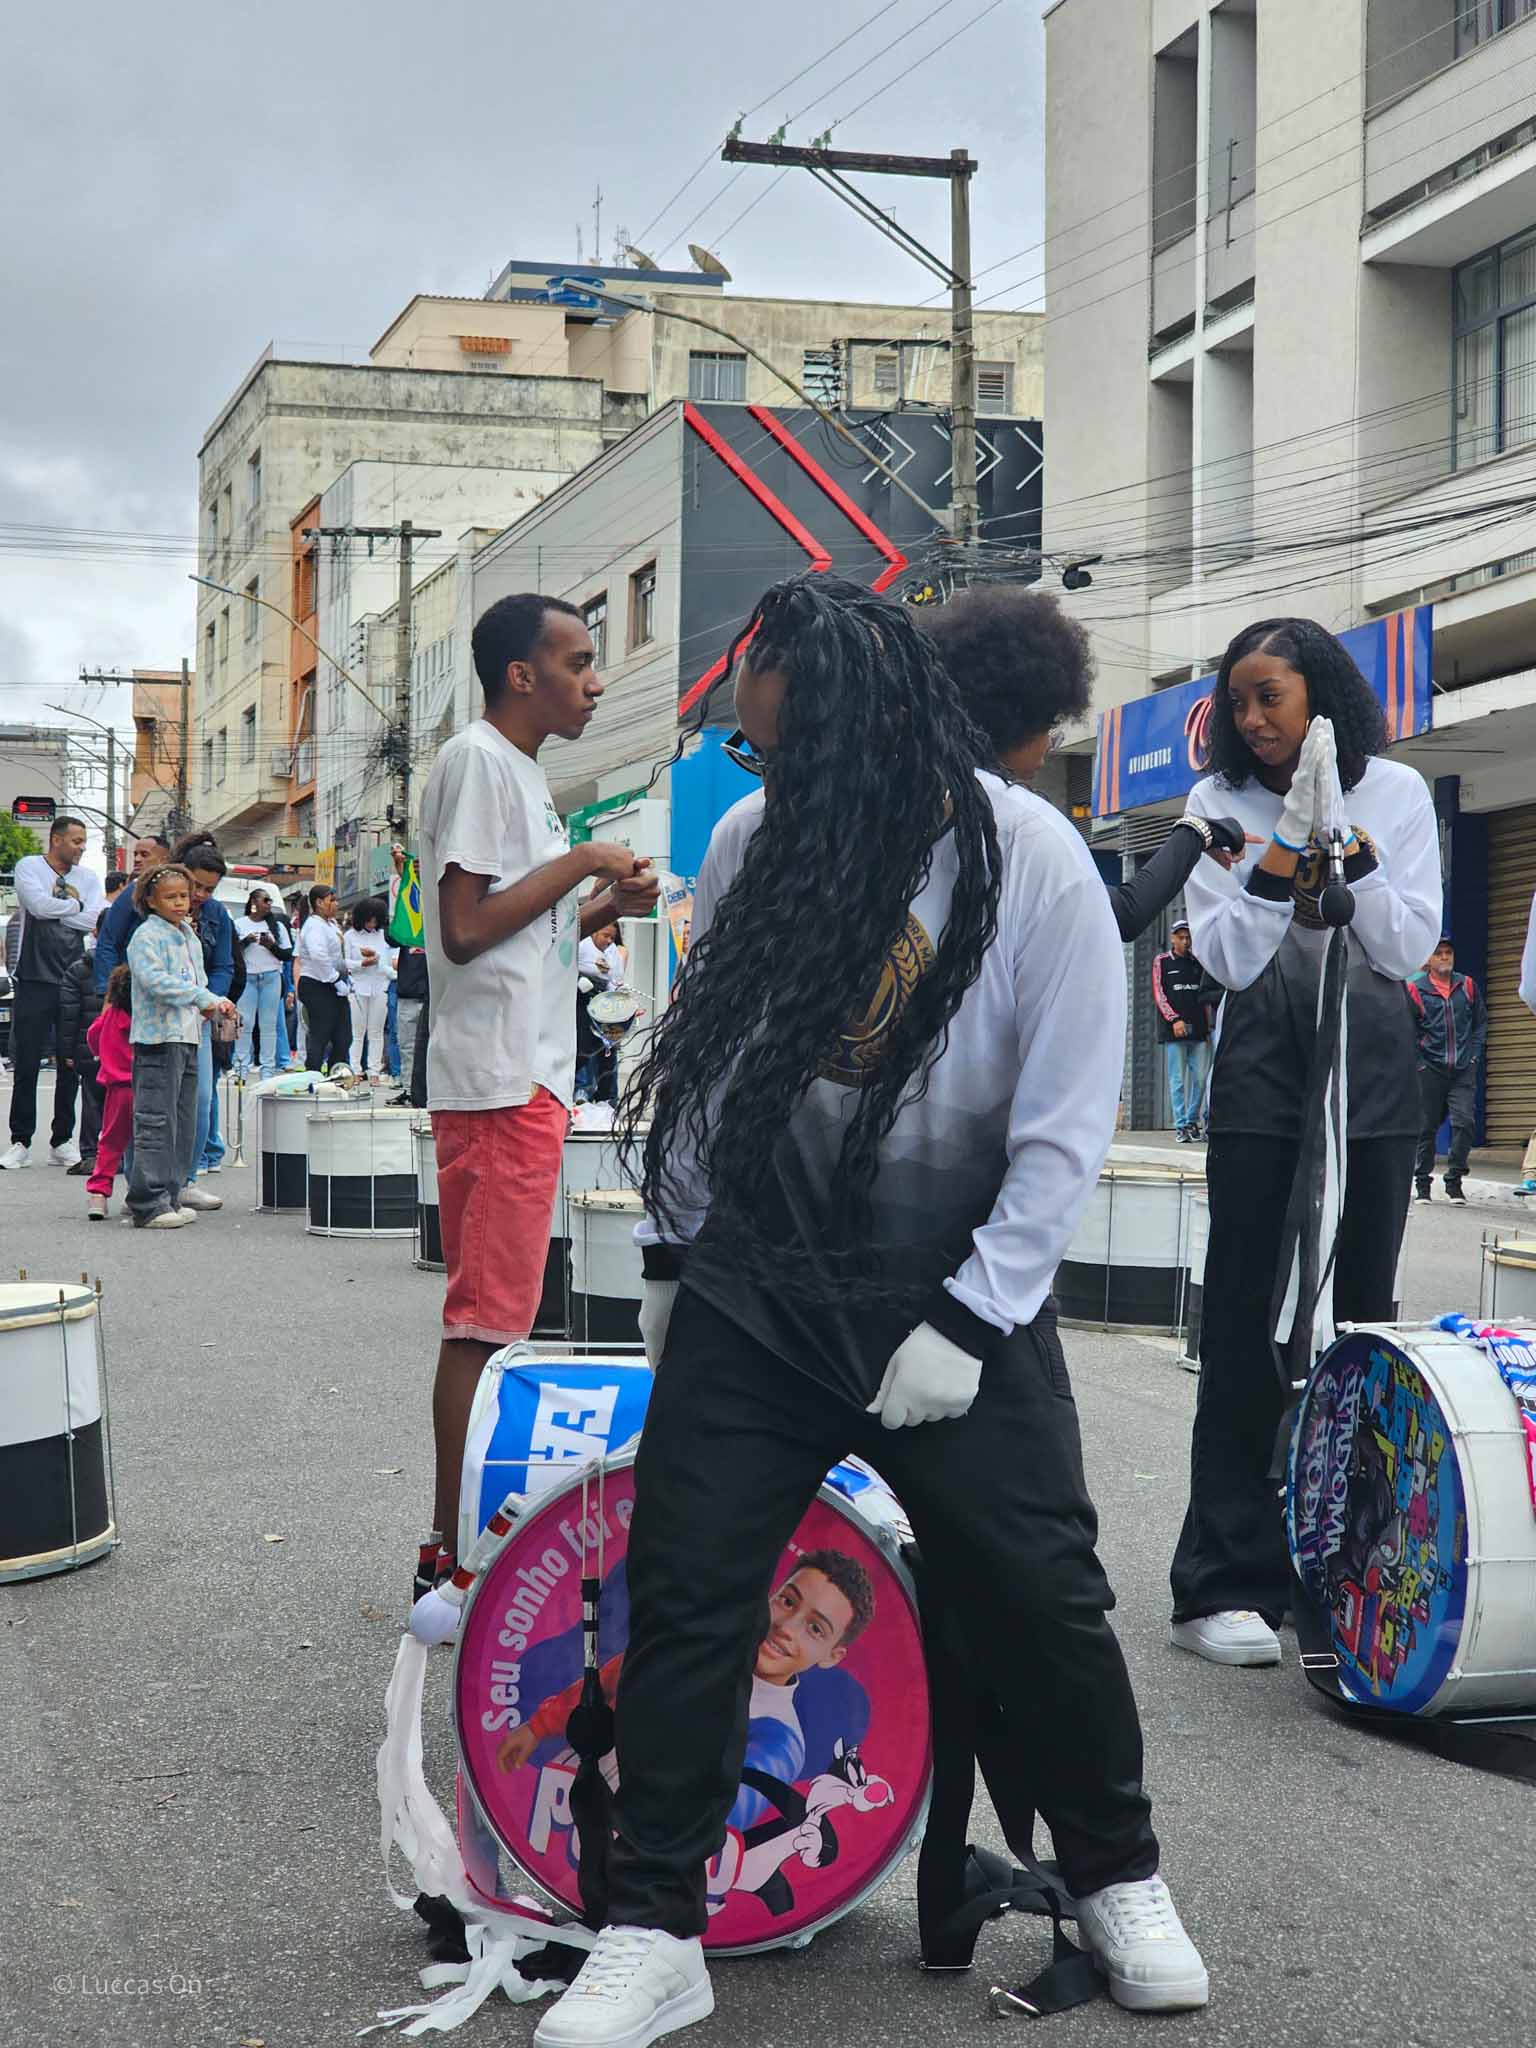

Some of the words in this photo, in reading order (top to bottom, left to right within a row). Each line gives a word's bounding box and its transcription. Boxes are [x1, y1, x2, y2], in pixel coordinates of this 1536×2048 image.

[525, 1382, 620, 1494] EA
[559, 1501, 613, 1558] foi
[498, 1548, 569, 1651] sonho
[481, 1660, 521, 1732] Seu
